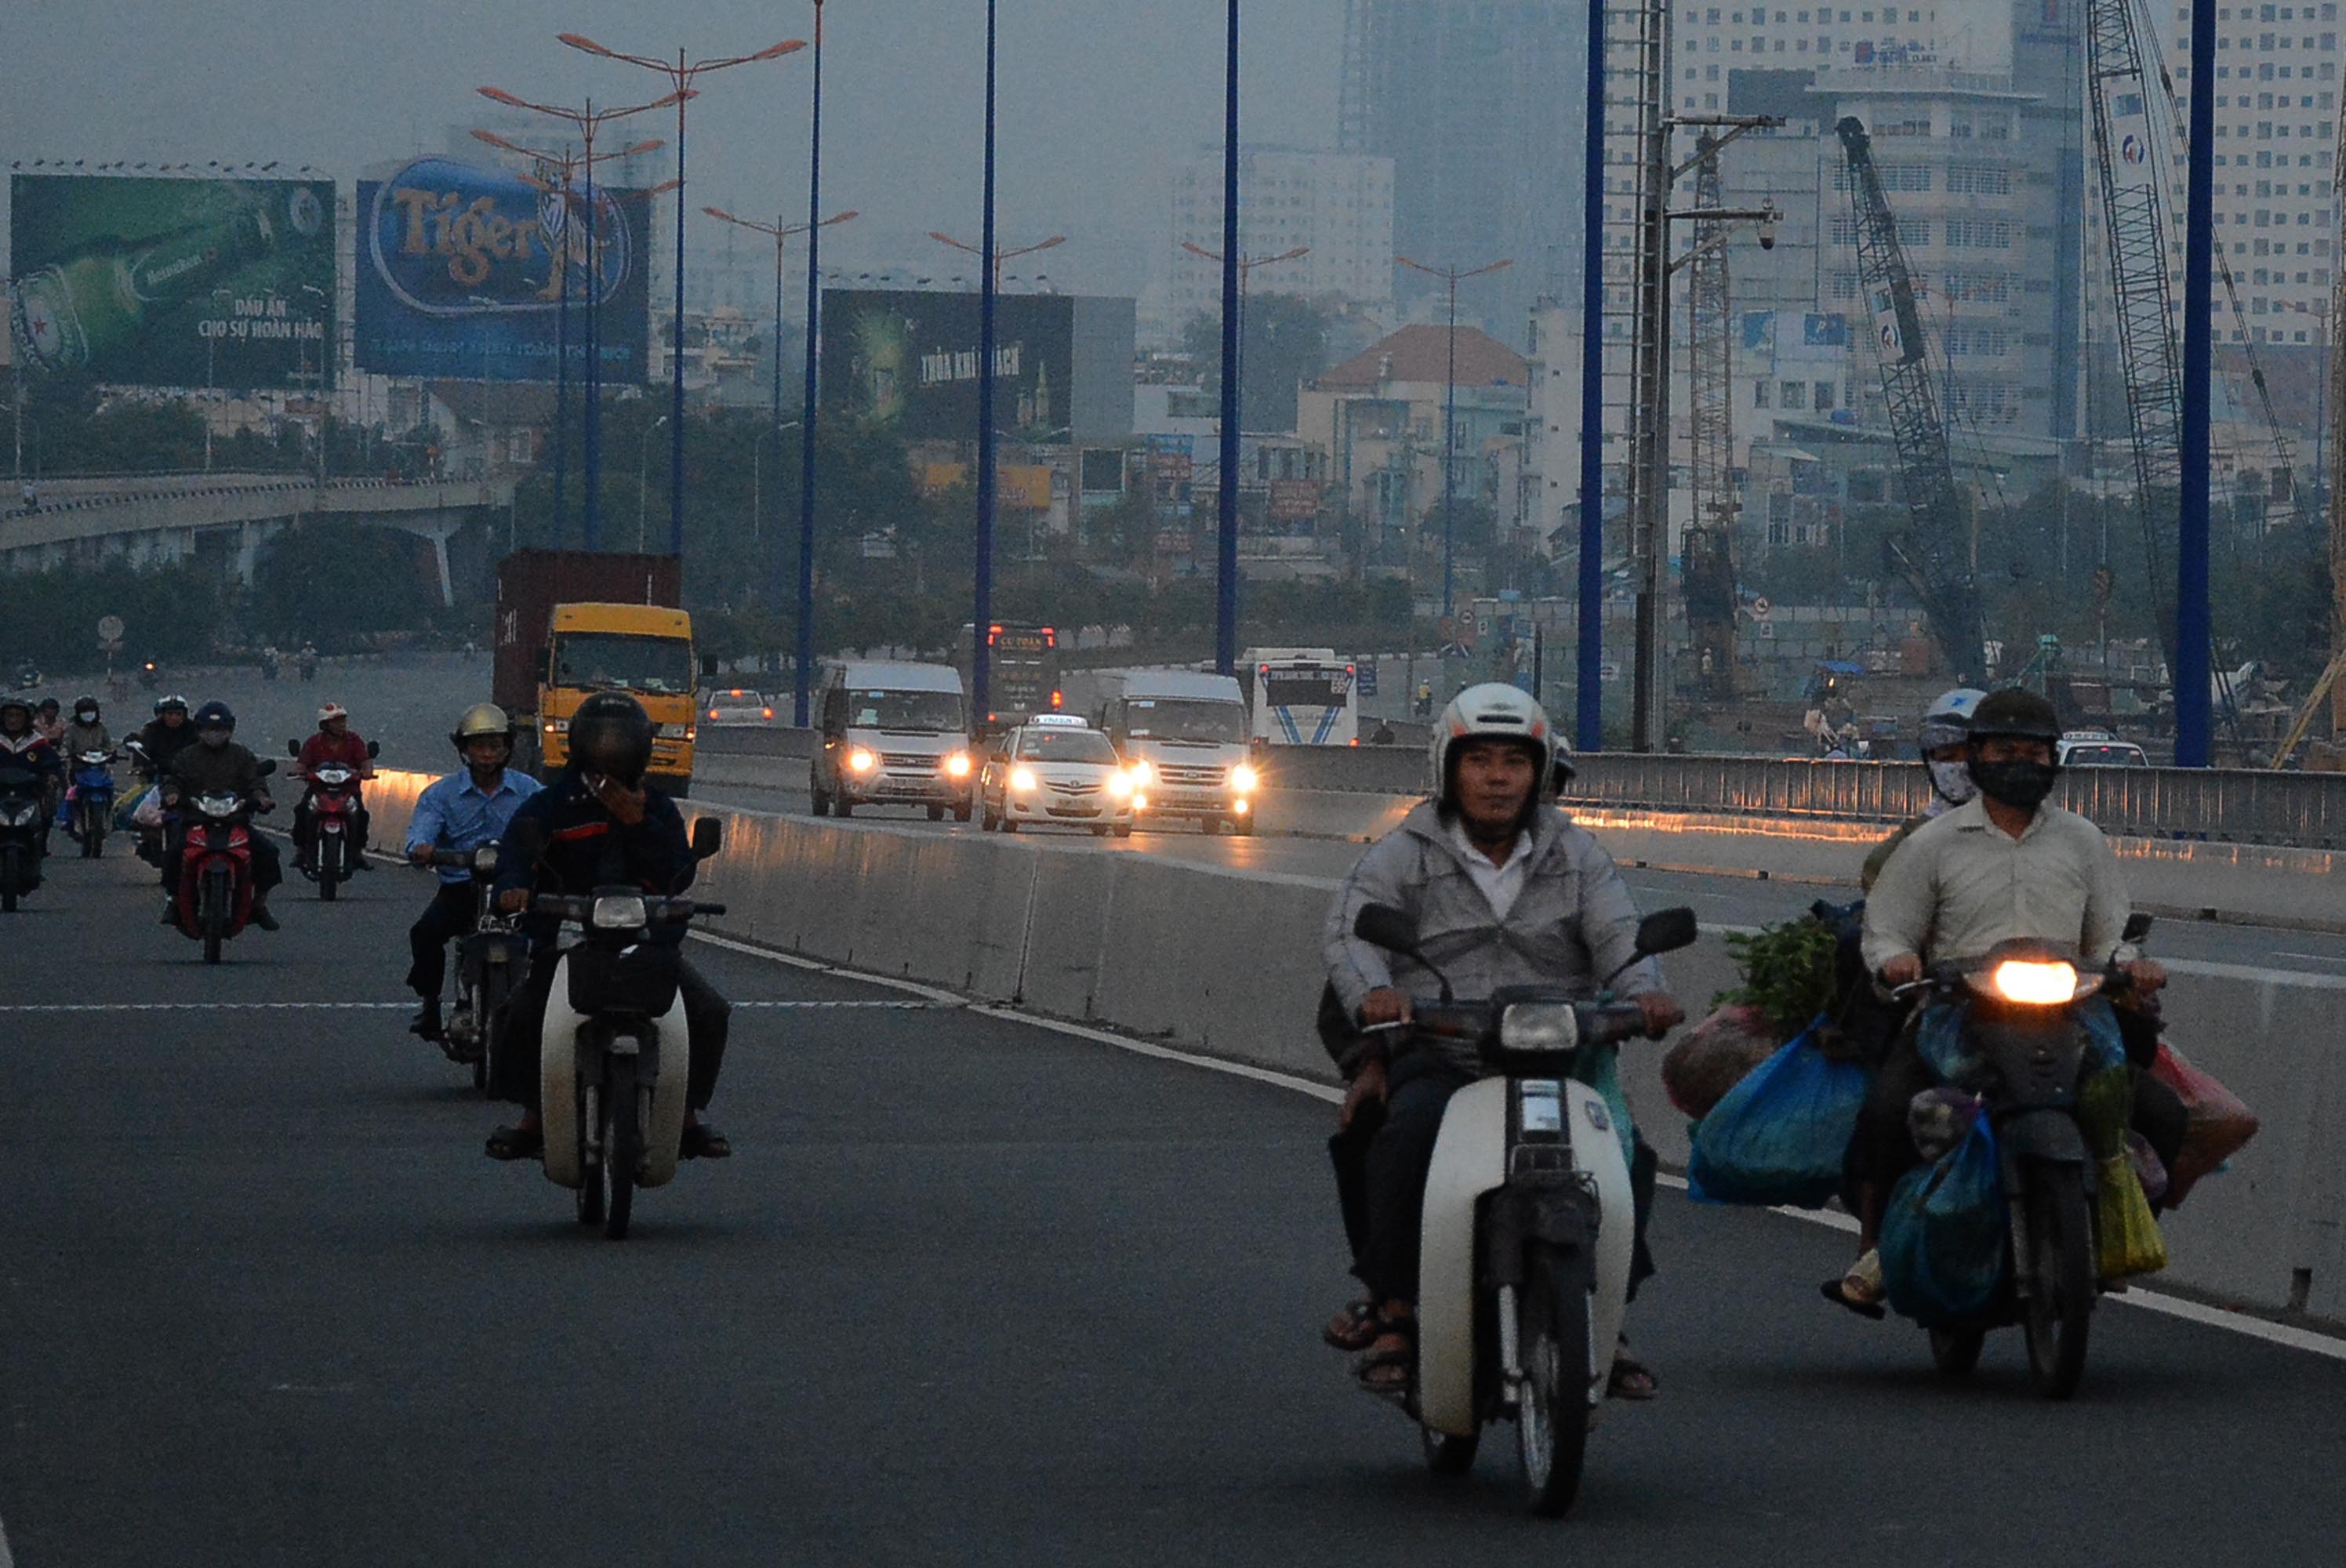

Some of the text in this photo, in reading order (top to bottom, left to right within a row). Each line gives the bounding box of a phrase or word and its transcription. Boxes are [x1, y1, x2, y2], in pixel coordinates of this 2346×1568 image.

[396, 187, 539, 287] Tiger
[198, 320, 227, 338] CHO
[978, 343, 1020, 377] ÁCH
